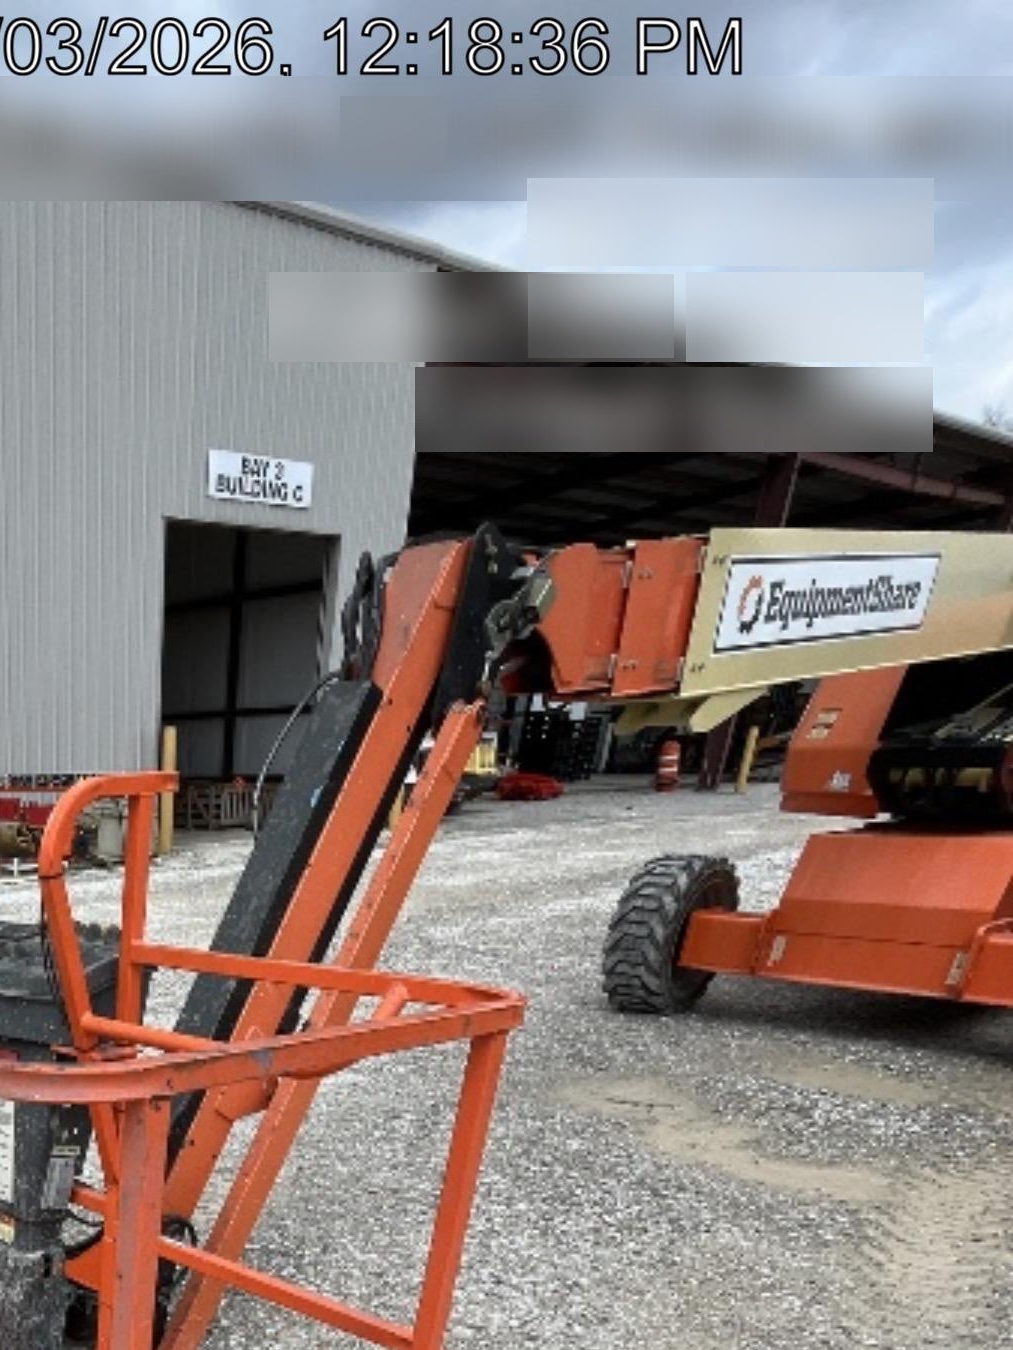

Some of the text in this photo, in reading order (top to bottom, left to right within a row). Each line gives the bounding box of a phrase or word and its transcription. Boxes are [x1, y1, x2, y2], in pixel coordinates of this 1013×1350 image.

[241, 456, 270, 478] BAY
[215, 473, 304, 502] BUILDING C
[764, 574, 921, 631] EquipmentShare
